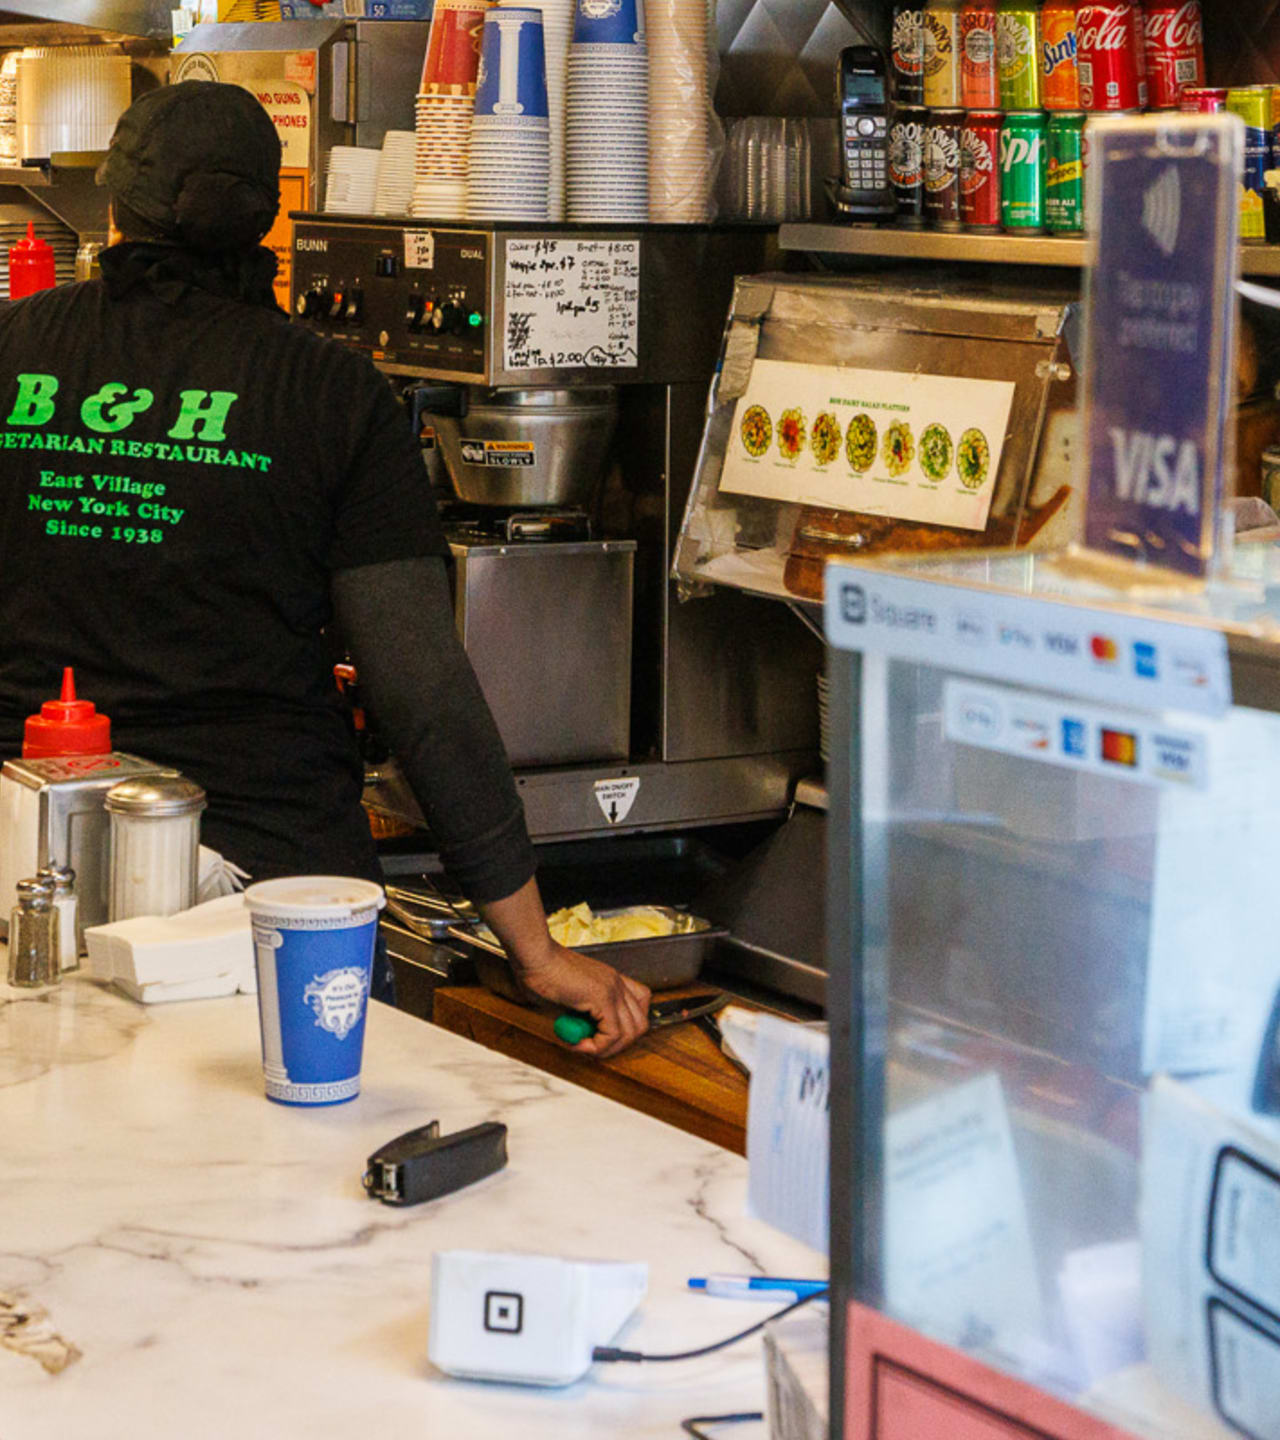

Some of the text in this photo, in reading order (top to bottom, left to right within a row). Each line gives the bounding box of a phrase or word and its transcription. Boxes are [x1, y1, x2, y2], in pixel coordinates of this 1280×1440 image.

[273, 92, 301, 106] GUNS
[272, 114, 308, 129] PHONES
[296, 238, 328, 252] BUNN
[6, 373, 238, 442] B & H
[110, 439, 273, 474] RESTAURANT
[39, 470, 167, 498] East Village
[1109, 428, 1200, 517] VISA
[27, 492, 185, 525] New York City
[45, 518, 164, 545] Since 1938
[870, 598, 937, 633] Square
